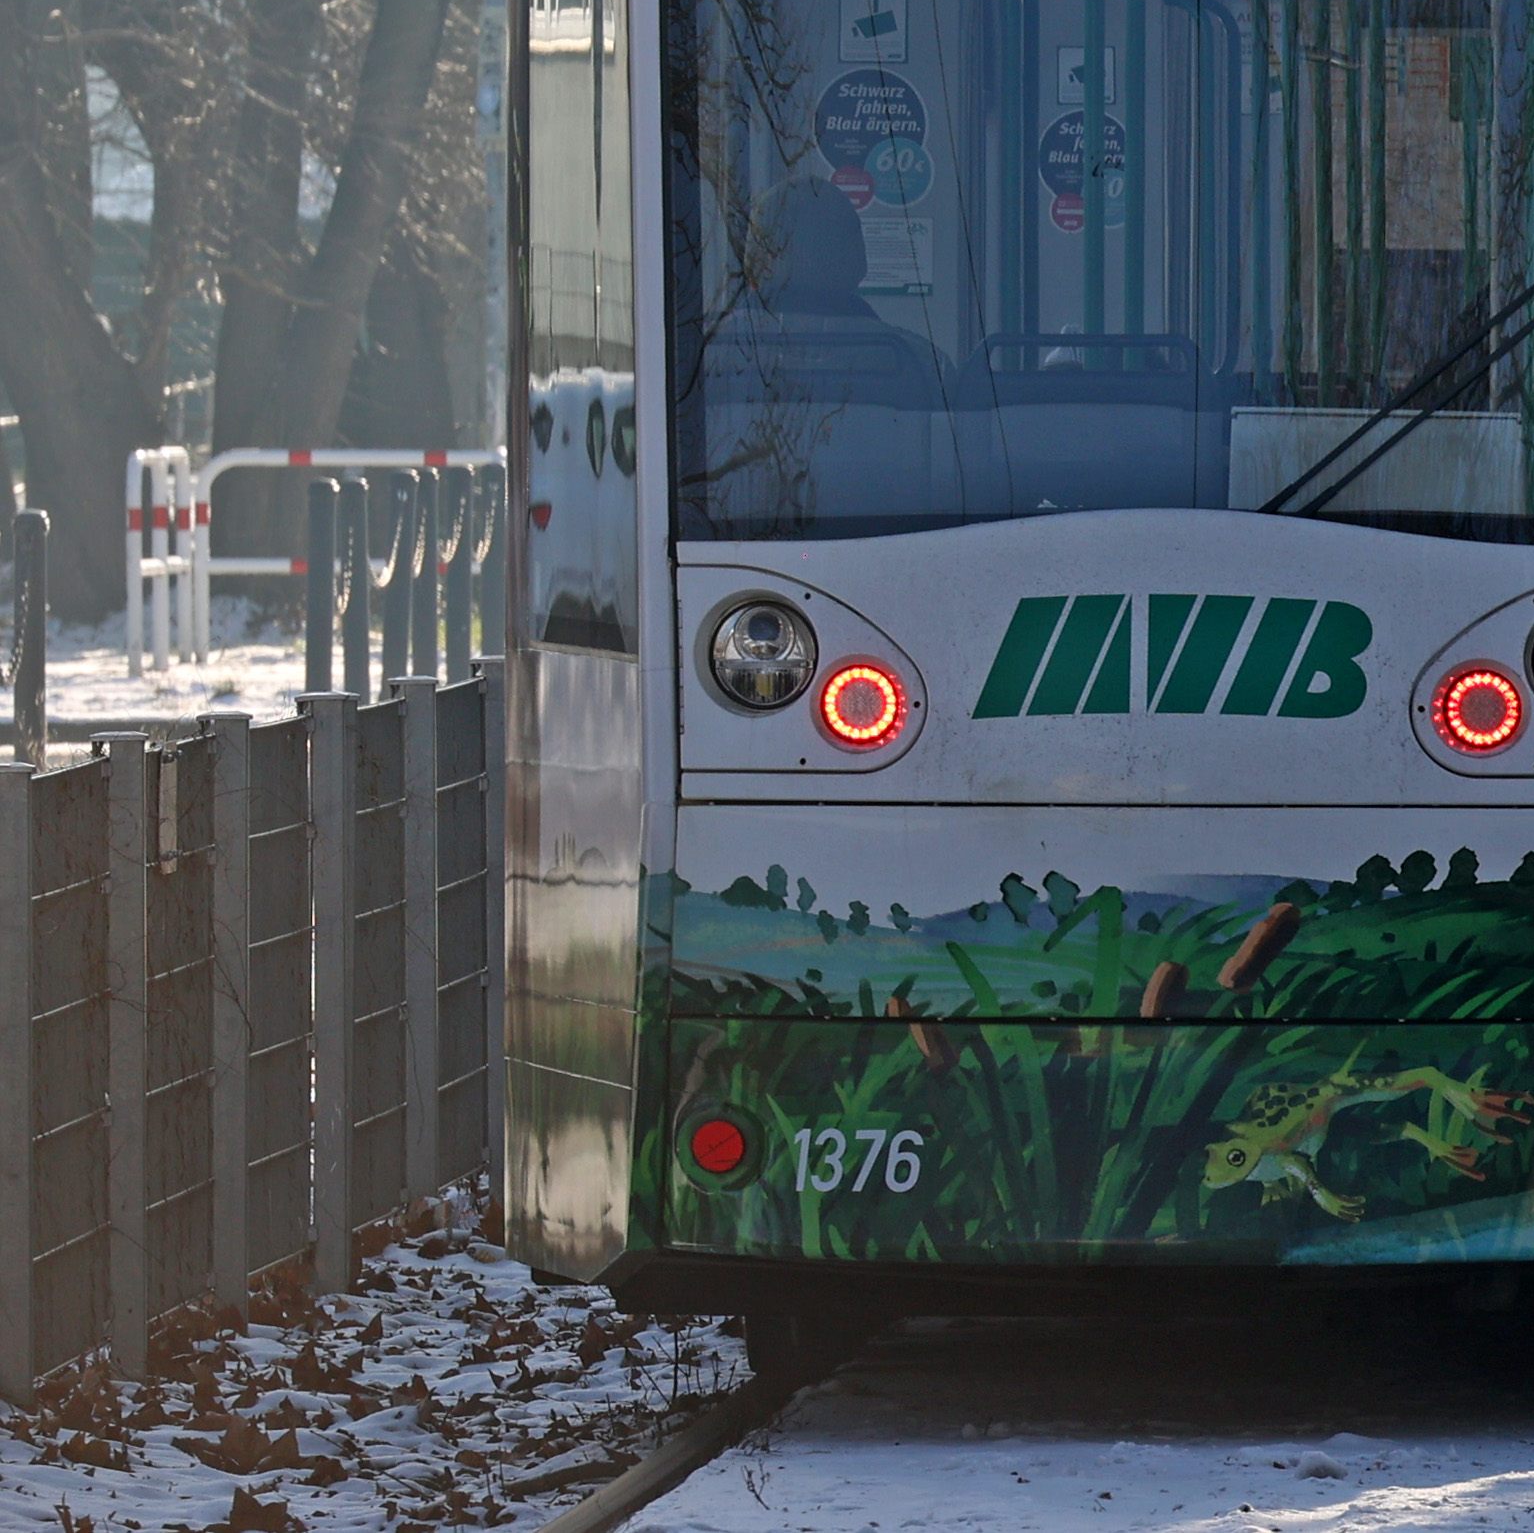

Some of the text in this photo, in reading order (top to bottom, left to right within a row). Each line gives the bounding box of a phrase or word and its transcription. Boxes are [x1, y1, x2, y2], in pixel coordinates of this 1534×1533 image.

[837, 82, 906, 98] Schwarz
[854, 99, 912, 118] fahren,
[825, 116, 922, 135] Blau ärgern.
[1048, 150, 1079, 164] Blau
[971, 592, 1374, 720] MVB
[793, 1126, 926, 1195] 1376
